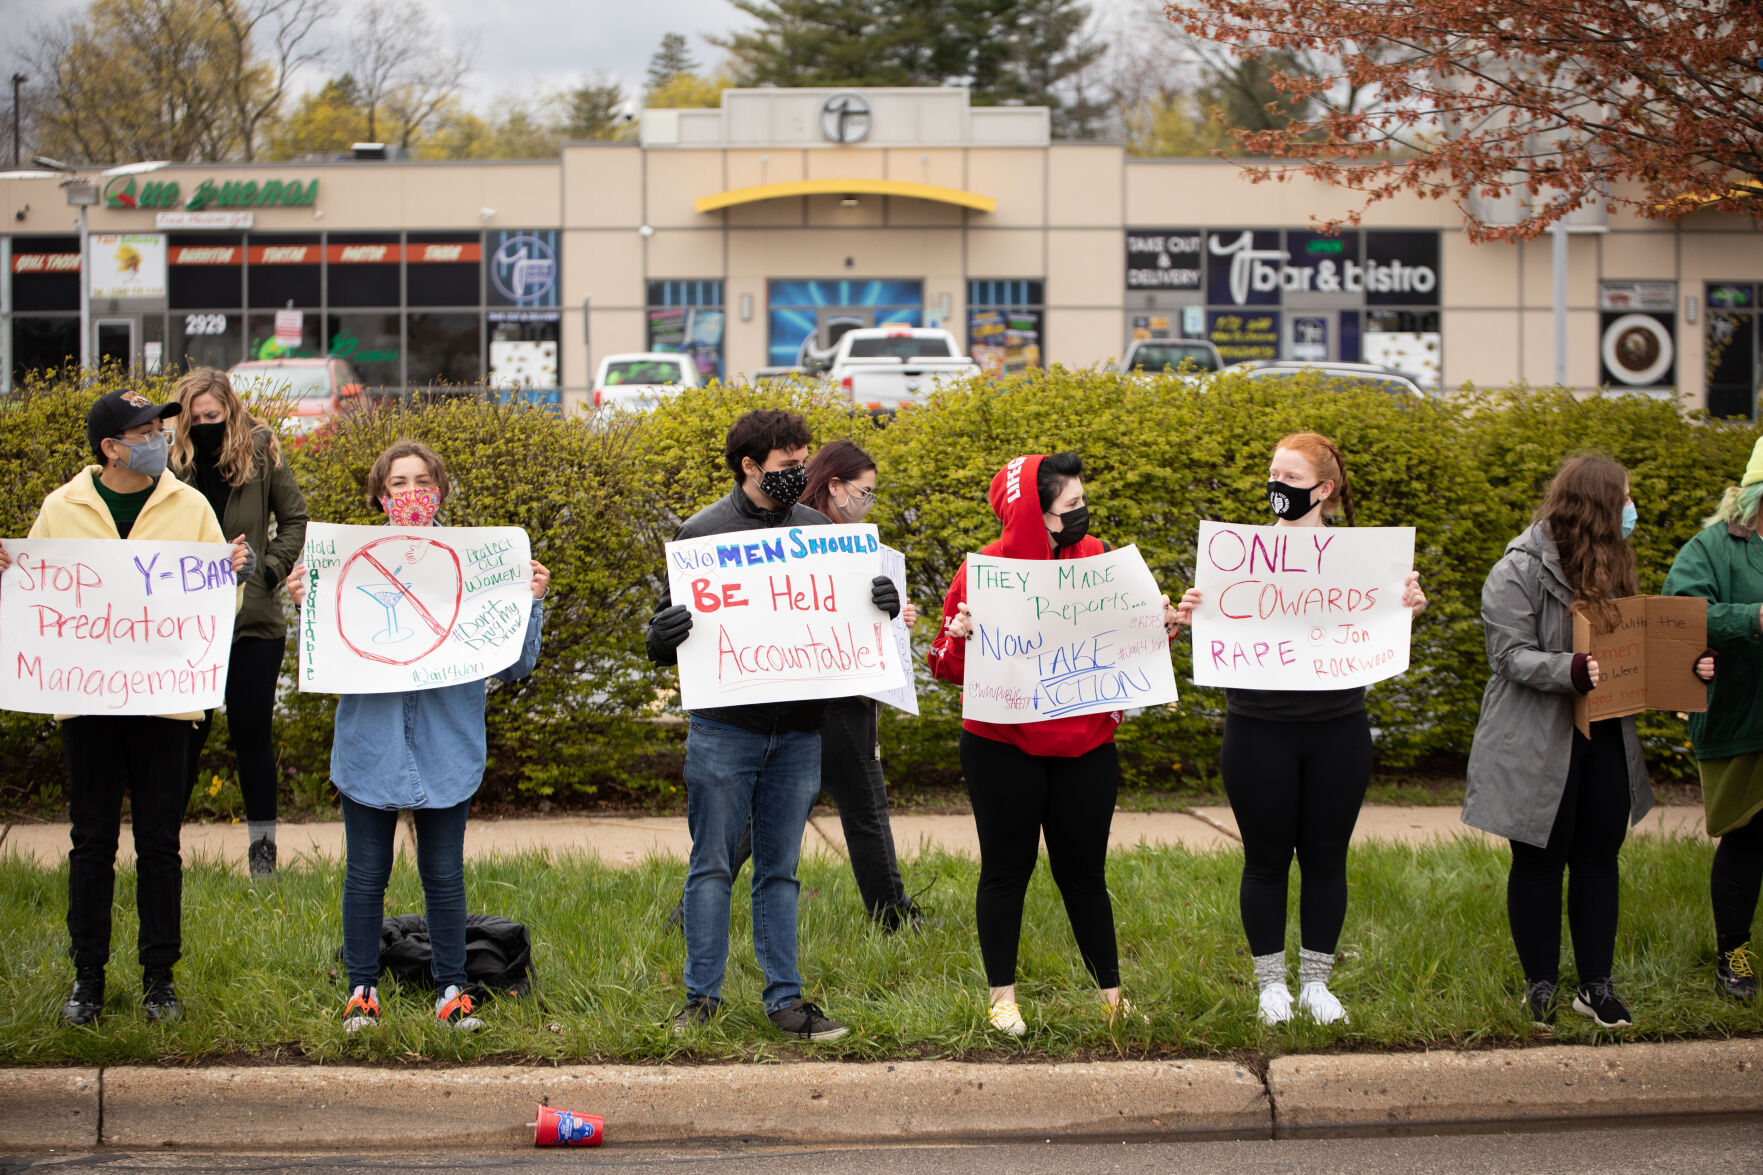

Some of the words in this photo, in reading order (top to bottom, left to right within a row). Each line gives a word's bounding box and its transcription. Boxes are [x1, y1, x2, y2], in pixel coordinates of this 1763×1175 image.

[103, 174, 180, 209] Que
[186, 178, 319, 211] Buenos
[1128, 236, 1166, 252] TAKE
[1168, 236, 1200, 252] OUT
[1156, 253, 1171, 268] &
[1344, 259, 1436, 293] bistro
[1128, 269, 1200, 287] DELIVERY
[185, 313, 227, 335] 2929
[304, 552, 341, 569] them
[306, 539, 335, 555] Hold
[464, 537, 513, 563] Protect
[1208, 529, 1336, 576] ONLY
[17, 552, 103, 608] Stop
[690, 577, 750, 613] BE
[769, 573, 838, 612] Held
[970, 564, 1031, 593] THEY
[1219, 580, 1380, 620] COWARDS
[28, 602, 216, 668] Predatory
[1333, 623, 1371, 645] Jon
[1621, 615, 1648, 631] with
[1658, 615, 1688, 630] the
[718, 621, 886, 680] Accountable!
[1026, 629, 1118, 677] TAKE
[1210, 640, 1297, 672] RAPE
[1313, 648, 1396, 680] ROCKWOOD
[17, 651, 226, 709] Management
[1032, 667, 1152, 711] ACTION
